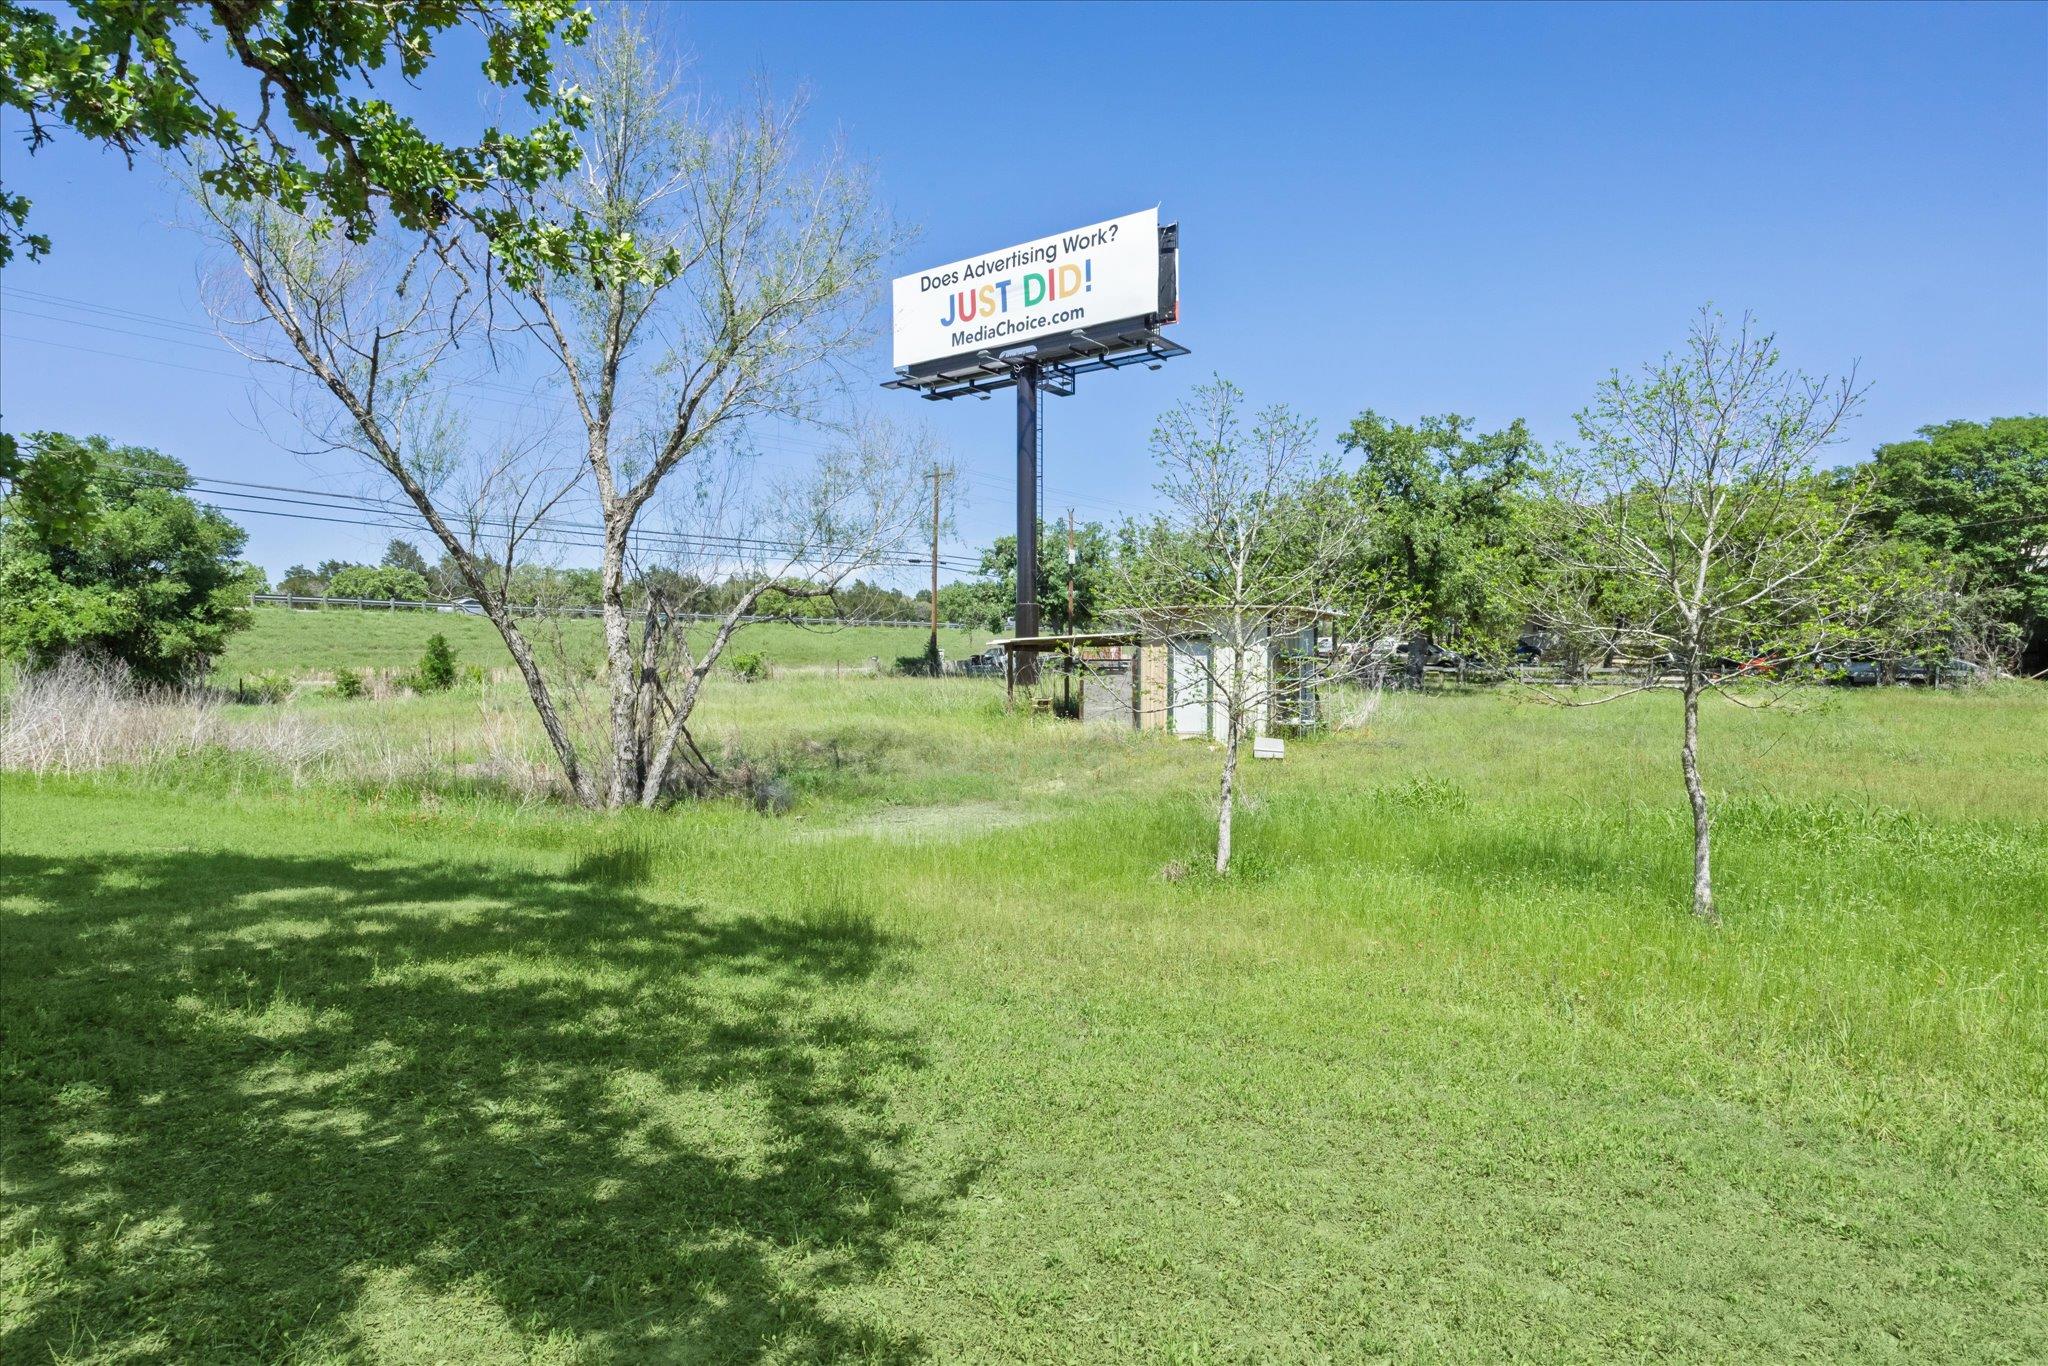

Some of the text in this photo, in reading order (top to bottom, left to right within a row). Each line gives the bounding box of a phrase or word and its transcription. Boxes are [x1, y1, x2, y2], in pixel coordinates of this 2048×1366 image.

[921, 224, 1118, 292] Does Advertising Work?
[941, 259, 1092, 327] JUST DID!
[952, 308, 1084, 347] MediaChoice.com
